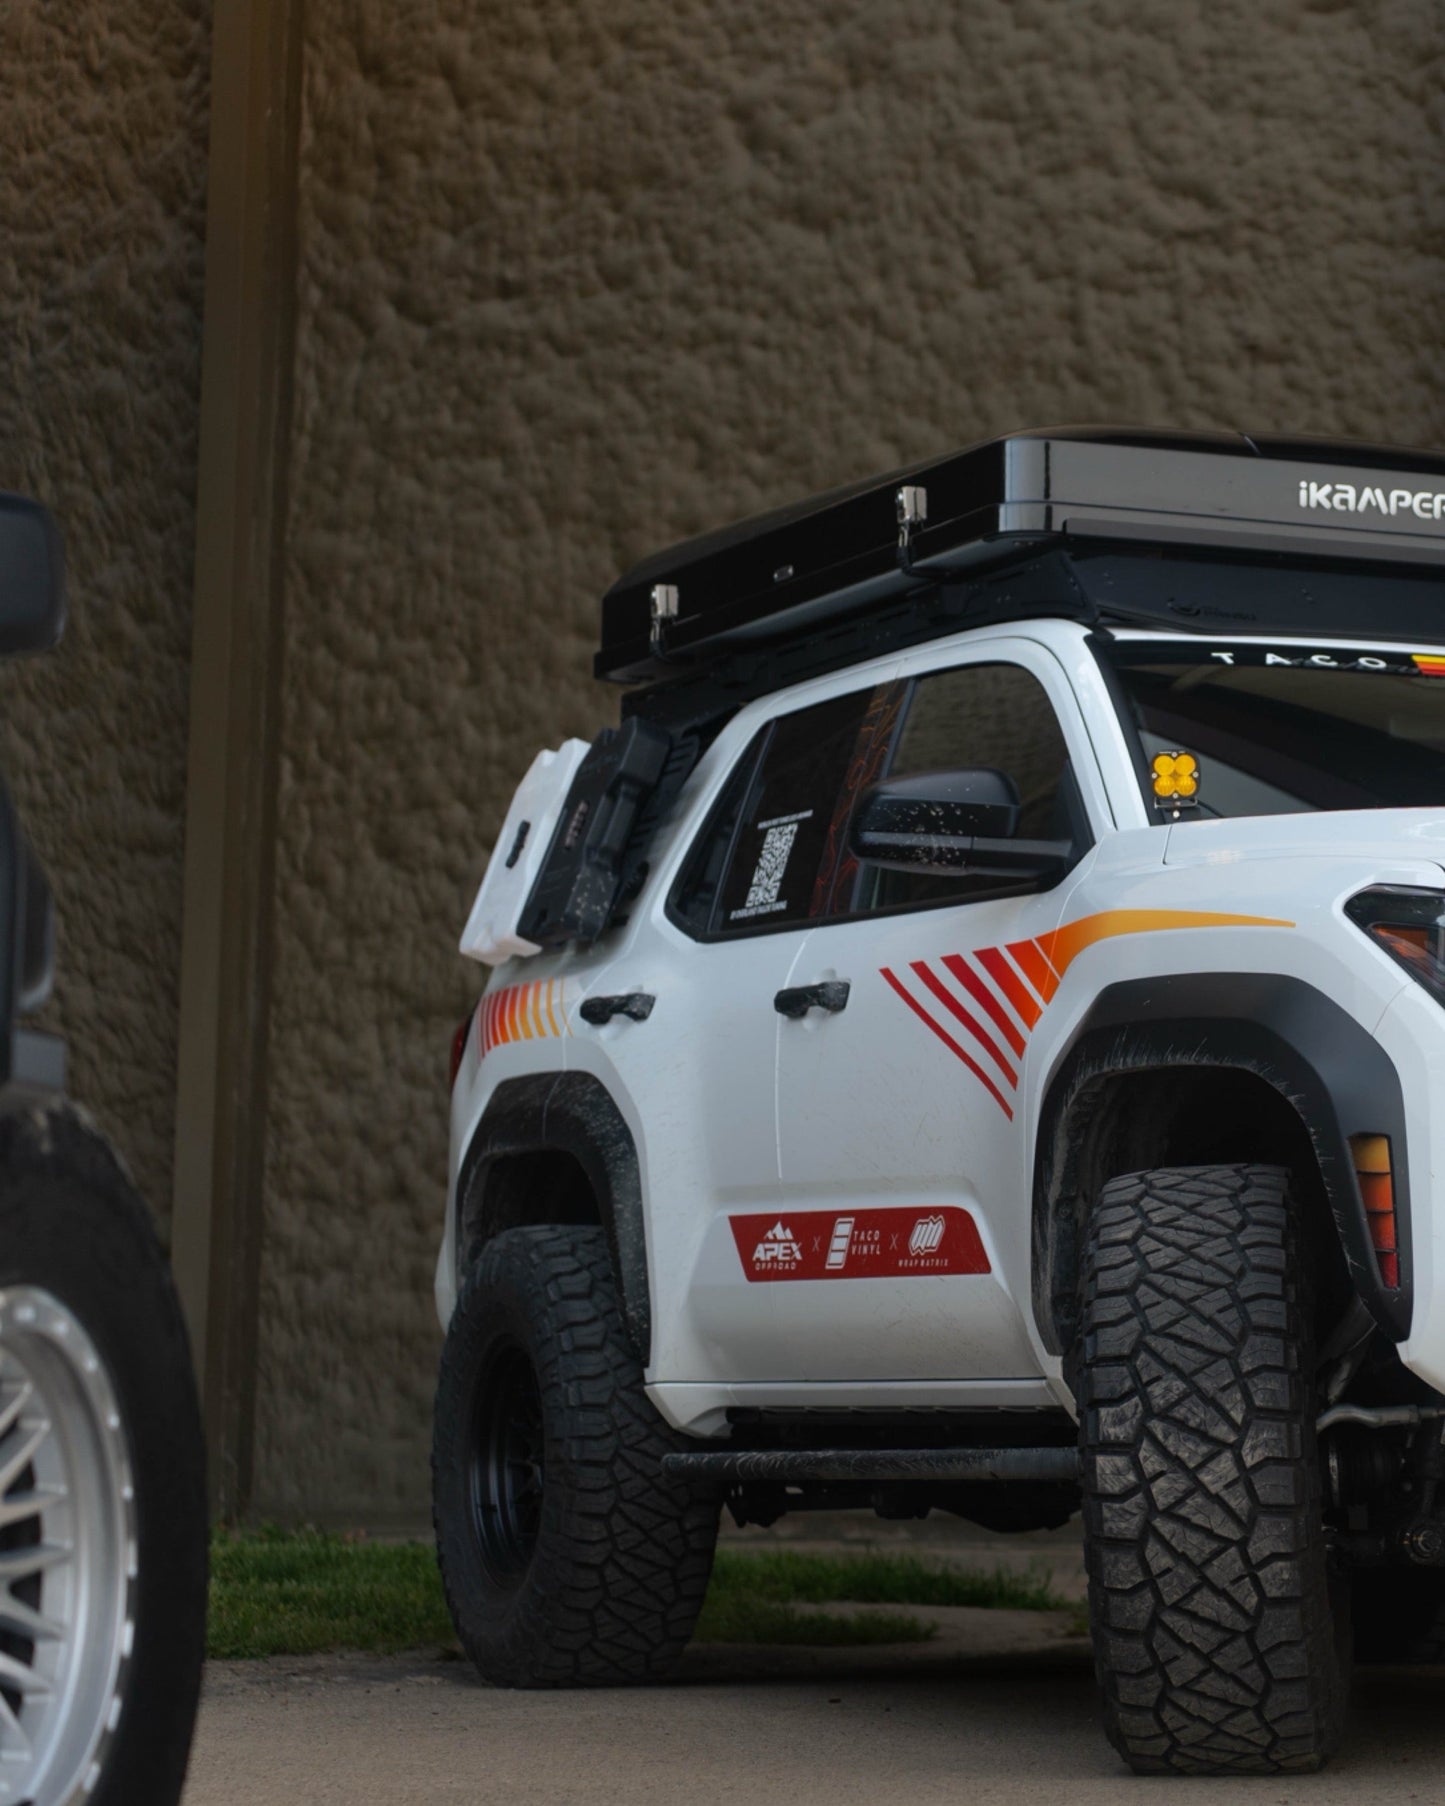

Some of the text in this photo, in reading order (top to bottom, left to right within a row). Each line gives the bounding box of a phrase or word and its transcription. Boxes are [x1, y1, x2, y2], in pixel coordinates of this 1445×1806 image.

[1211, 652, 1387, 669] TACO
[853, 1230, 880, 1242] TACO
[752, 1241, 803, 1261] APEX
[851, 1243, 880, 1256] VINYL
